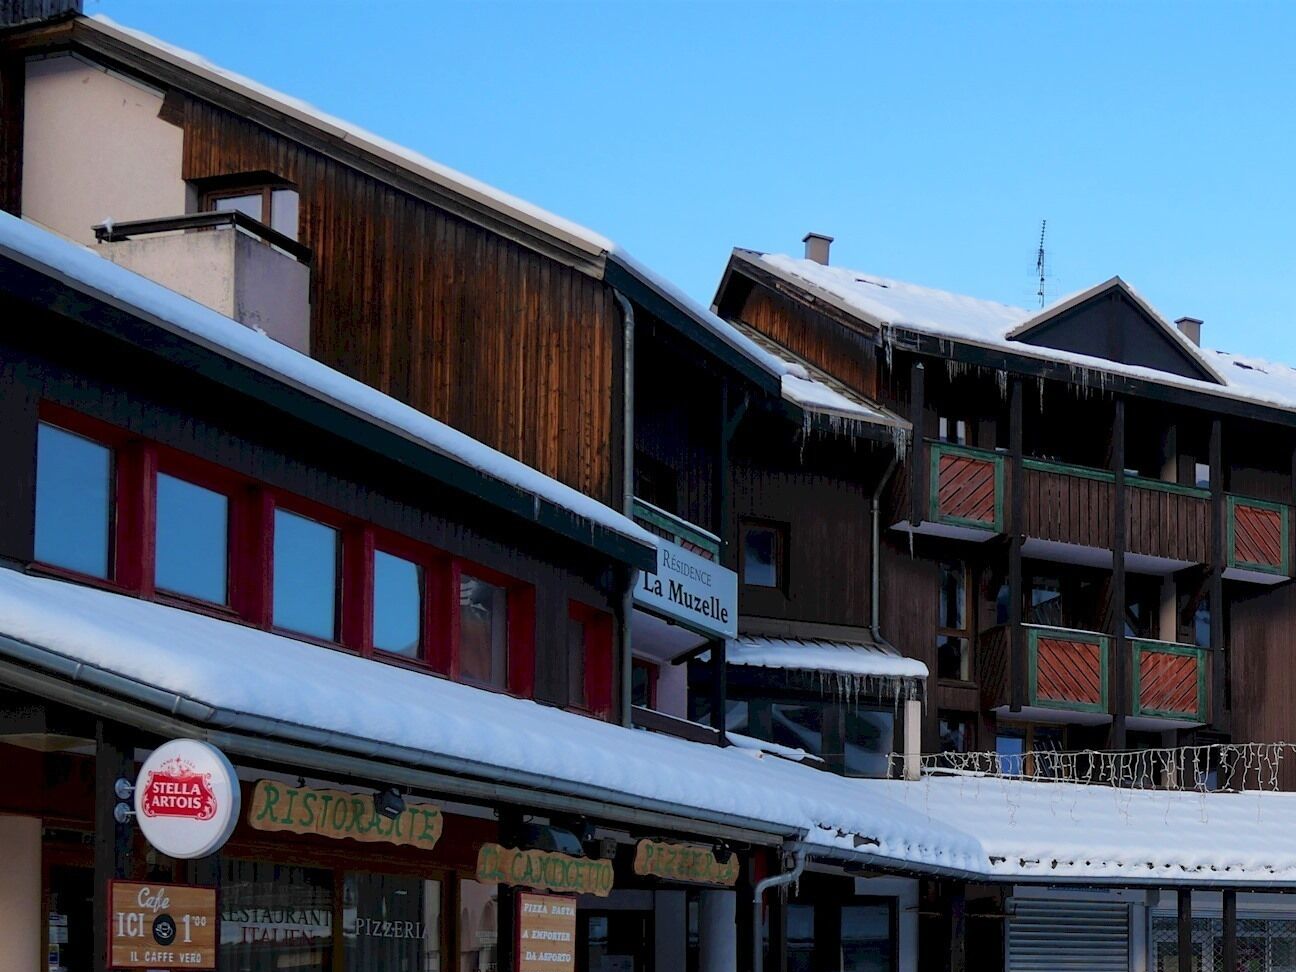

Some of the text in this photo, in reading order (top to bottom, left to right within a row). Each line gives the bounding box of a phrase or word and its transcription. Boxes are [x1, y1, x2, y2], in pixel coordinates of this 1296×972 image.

[662, 549, 712, 587] RÉSIDENCE
[643, 570, 728, 624] La Muzelle
[152, 782, 201, 795] STELLA
[151, 795, 202, 809] ARTOIS
[137, 887, 171, 913] Cafe
[524, 903, 548, 914] PIZZA
[116, 912, 145, 937] ICI
[241, 926, 314, 945] ITALIEN
[532, 930, 571, 942] EMPORTER
[130, 951, 202, 963] IL CAFFE VERO
[525, 951, 572, 962] DA ASPORTO
